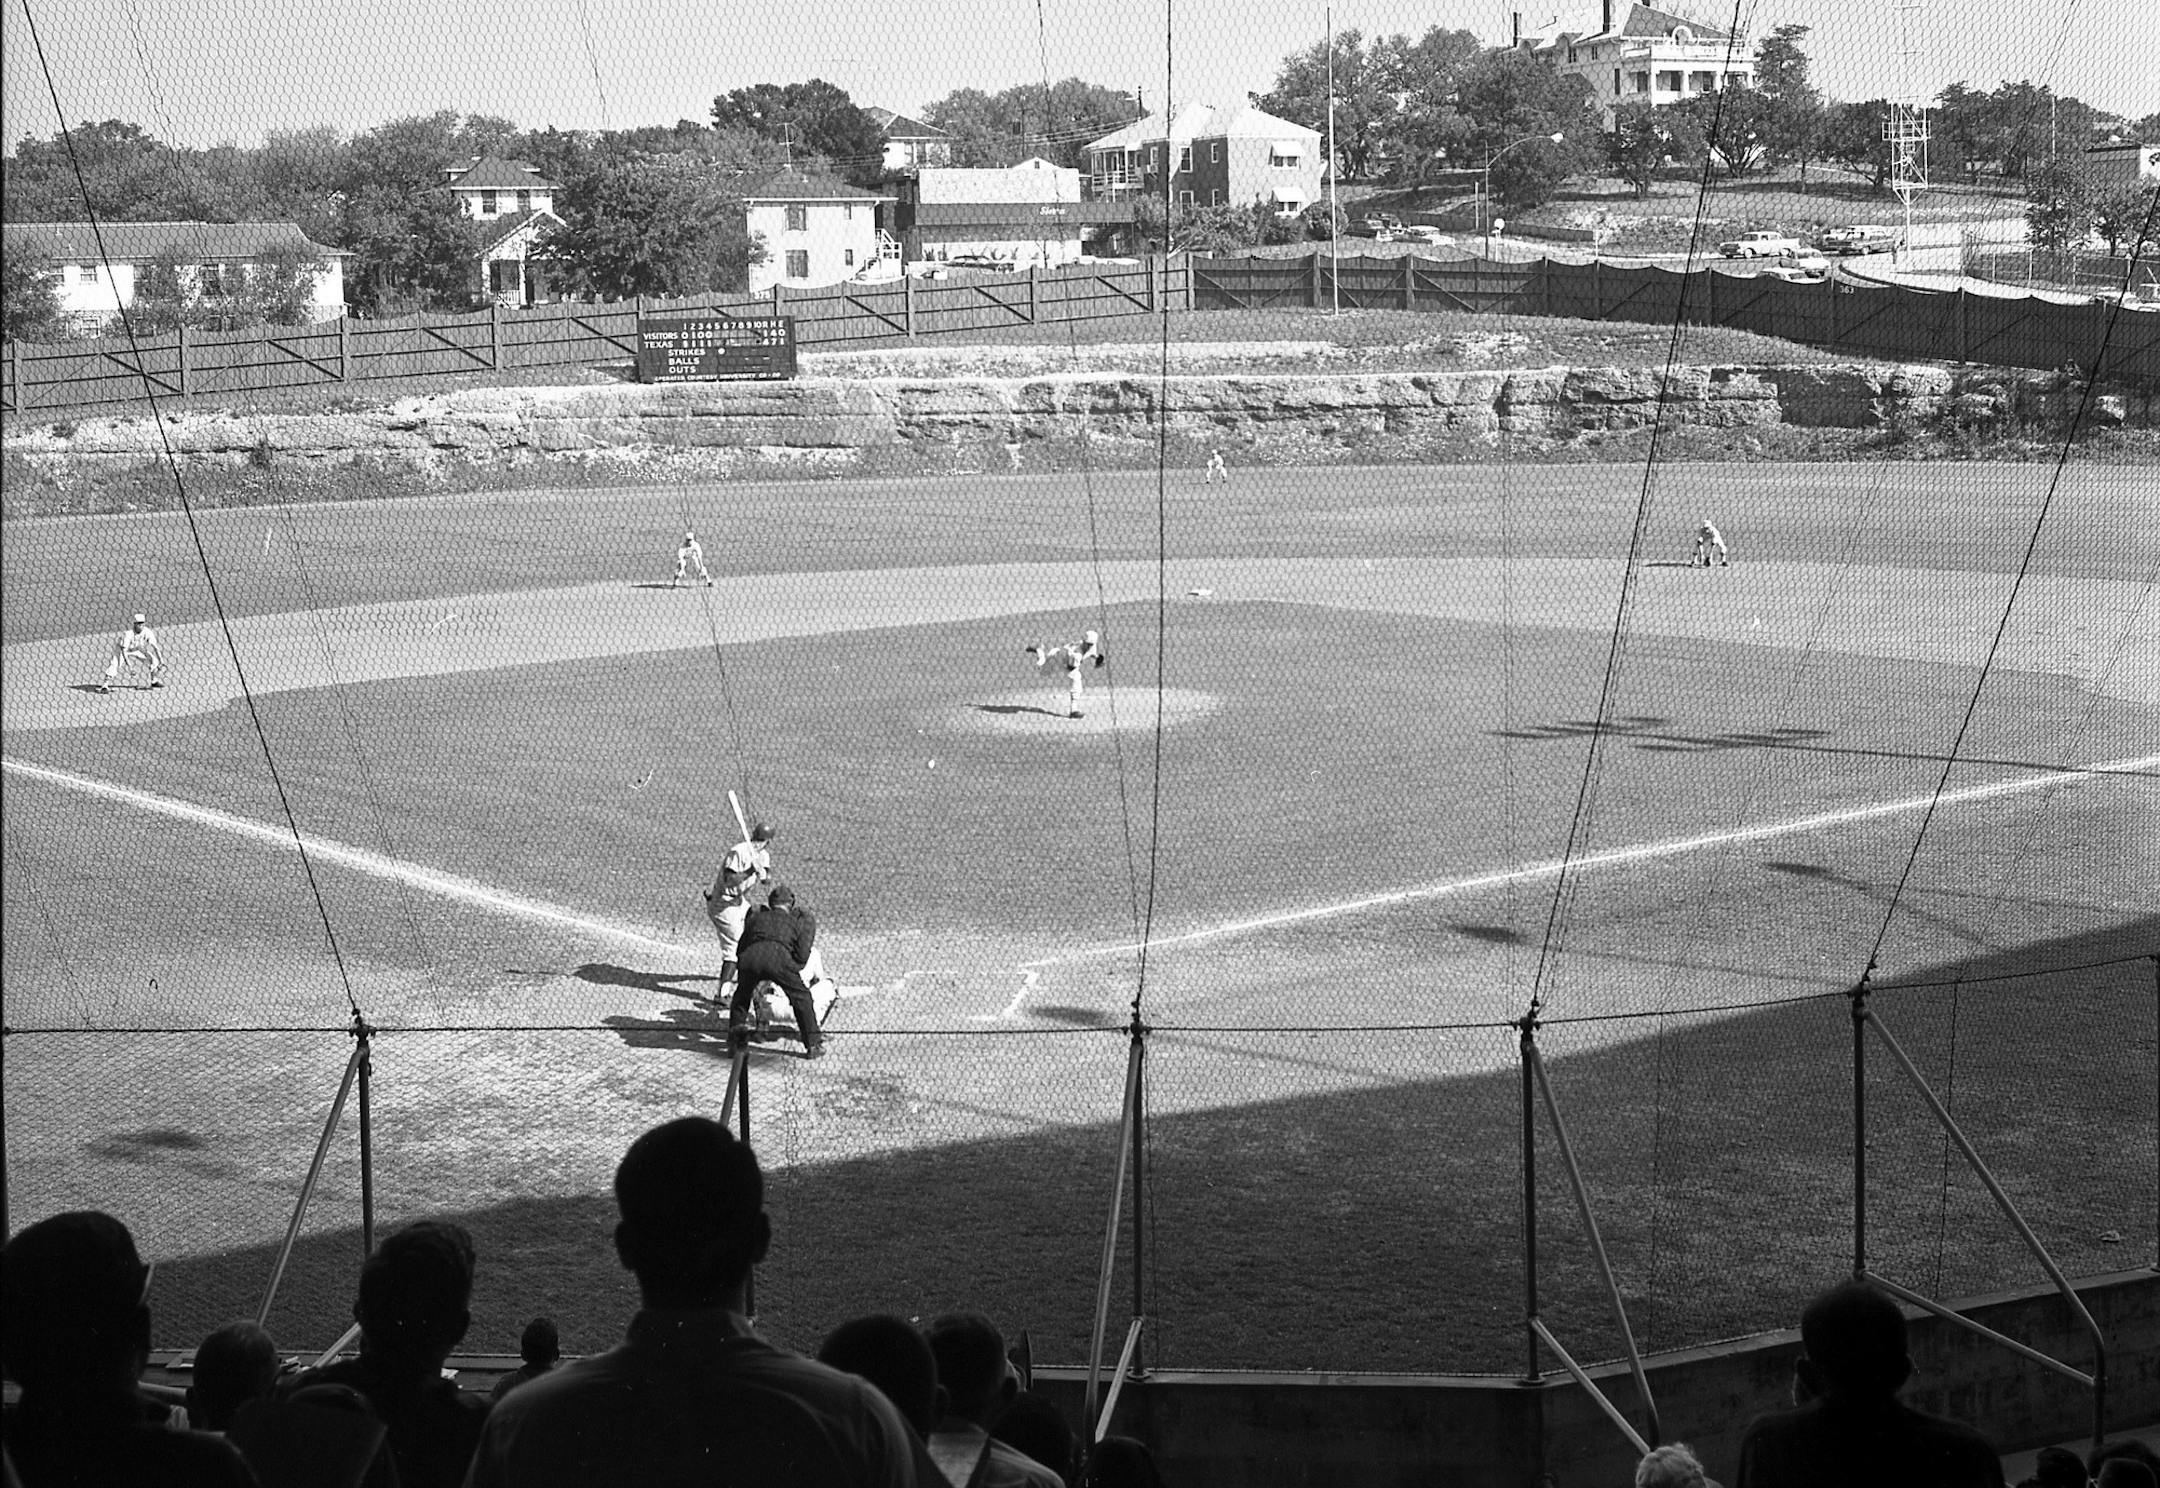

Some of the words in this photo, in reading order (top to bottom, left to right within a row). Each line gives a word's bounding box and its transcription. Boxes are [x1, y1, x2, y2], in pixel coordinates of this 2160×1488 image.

[643, 332, 678, 340] VISITORS
[668, 348, 706, 356] STRIKES
[668, 357, 700, 366] BALLS
[669, 366, 696, 374] OUTS
